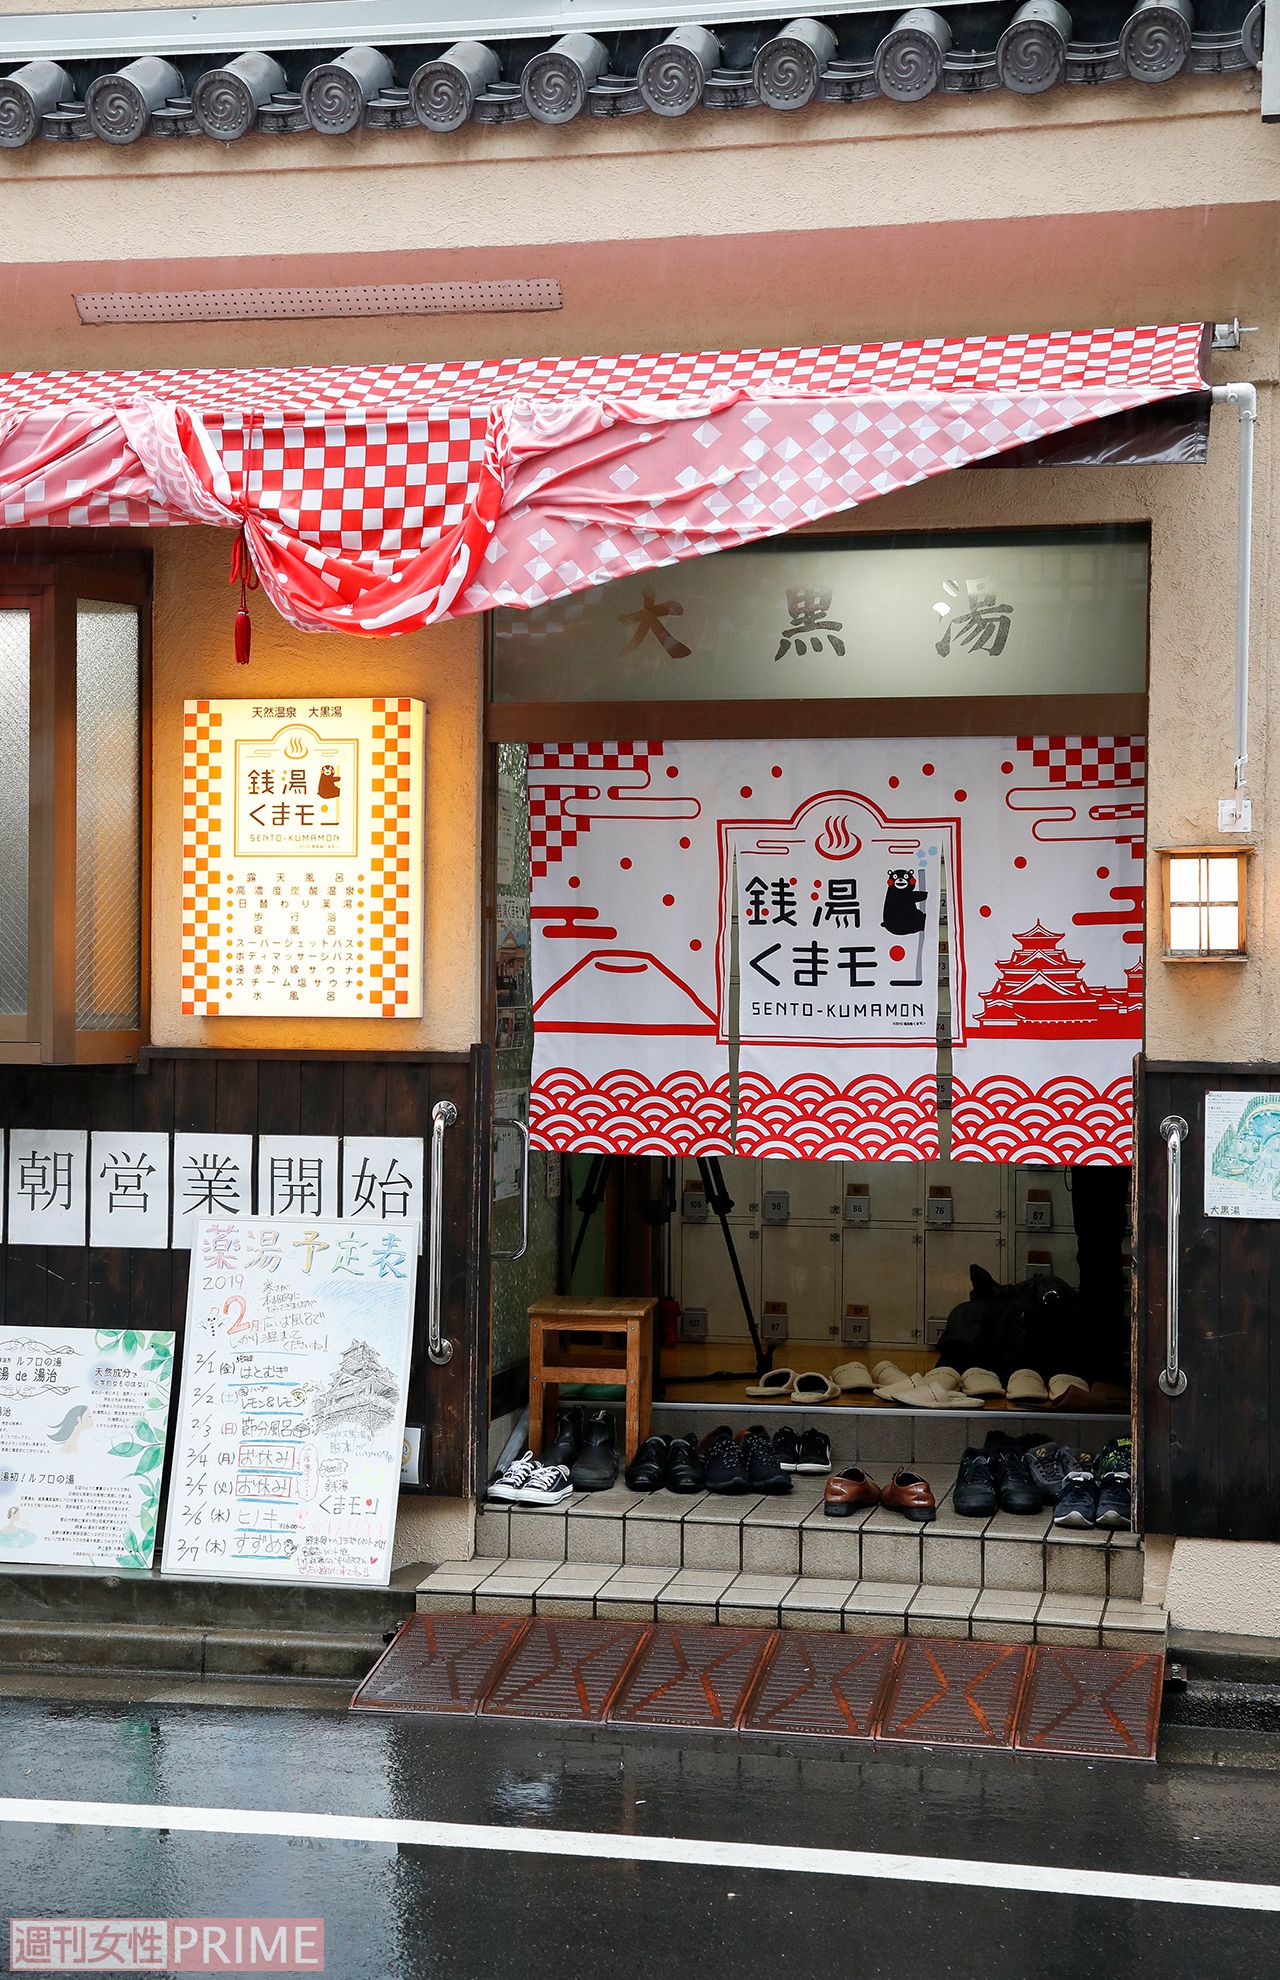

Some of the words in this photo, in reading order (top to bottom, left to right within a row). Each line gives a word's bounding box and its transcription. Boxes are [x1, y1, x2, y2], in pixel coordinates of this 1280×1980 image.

[619, 577, 1013, 661] 大黒湯
[252, 706, 297, 718] 天然温泉
[308, 706, 342, 718] 大黒湯
[247, 769, 307, 795] 銭湯
[249, 801, 340, 826] くまモン
[249, 833, 340, 842] SENTO-KUMAMON
[246, 872, 344, 883] 露天風呂
[238, 898, 353, 909] 日替わり薬湯
[745, 875, 860, 929] 銭湯
[254, 911, 337, 922] 歩行浴
[235, 964, 353, 974] 遠赤外線サウナ
[749, 939, 923, 987] くまモン
[252, 990, 336, 1001] 水風呂
[752, 1002, 924, 1018] SENTO-KUMAMON
[17, 1150, 414, 1219] 朝営業開始
[935, 1206, 945, 1215] 76
[1032, 1211, 1044, 1220] 67
[1210, 1205, 1240, 1216] 大黒湯
[203, 1225, 408, 1279] 薬湯予定表
[202, 1274, 245, 1290] 2019
[223, 1295, 260, 1335] 2月
[16, 1356, 63, 1368] ルフロの湯
[194, 1350, 216, 1375] 2/1
[239, 1364, 289, 1380] はとむぎ
[15, 1370, 28, 1382] de
[33, 1367, 58, 1383] 湯治
[191, 1383, 216, 1408] 2/2
[190, 1413, 213, 1439] 2/3
[221, 1421, 238, 1436] (日)
[241, 1416, 293, 1438] 節分風呂
[186, 1442, 212, 1468] 2/4
[217, 1451, 236, 1466] (月)
[240, 1449, 290, 1467] お休み
[185, 1472, 207, 1497] 2/5
[213, 1480, 233, 1496] (火)
[237, 1476, 288, 1495] お休み
[181, 1501, 208, 1527] 2/6
[210, 1507, 231, 1523] (水)
[238, 1508, 278, 1529] ヒノキ
[318, 1494, 379, 1516] くまモン
[177, 1536, 200, 1562] 2/7
[205, 1538, 227, 1557] (木)
[233, 1533, 282, 1554] すずめ
